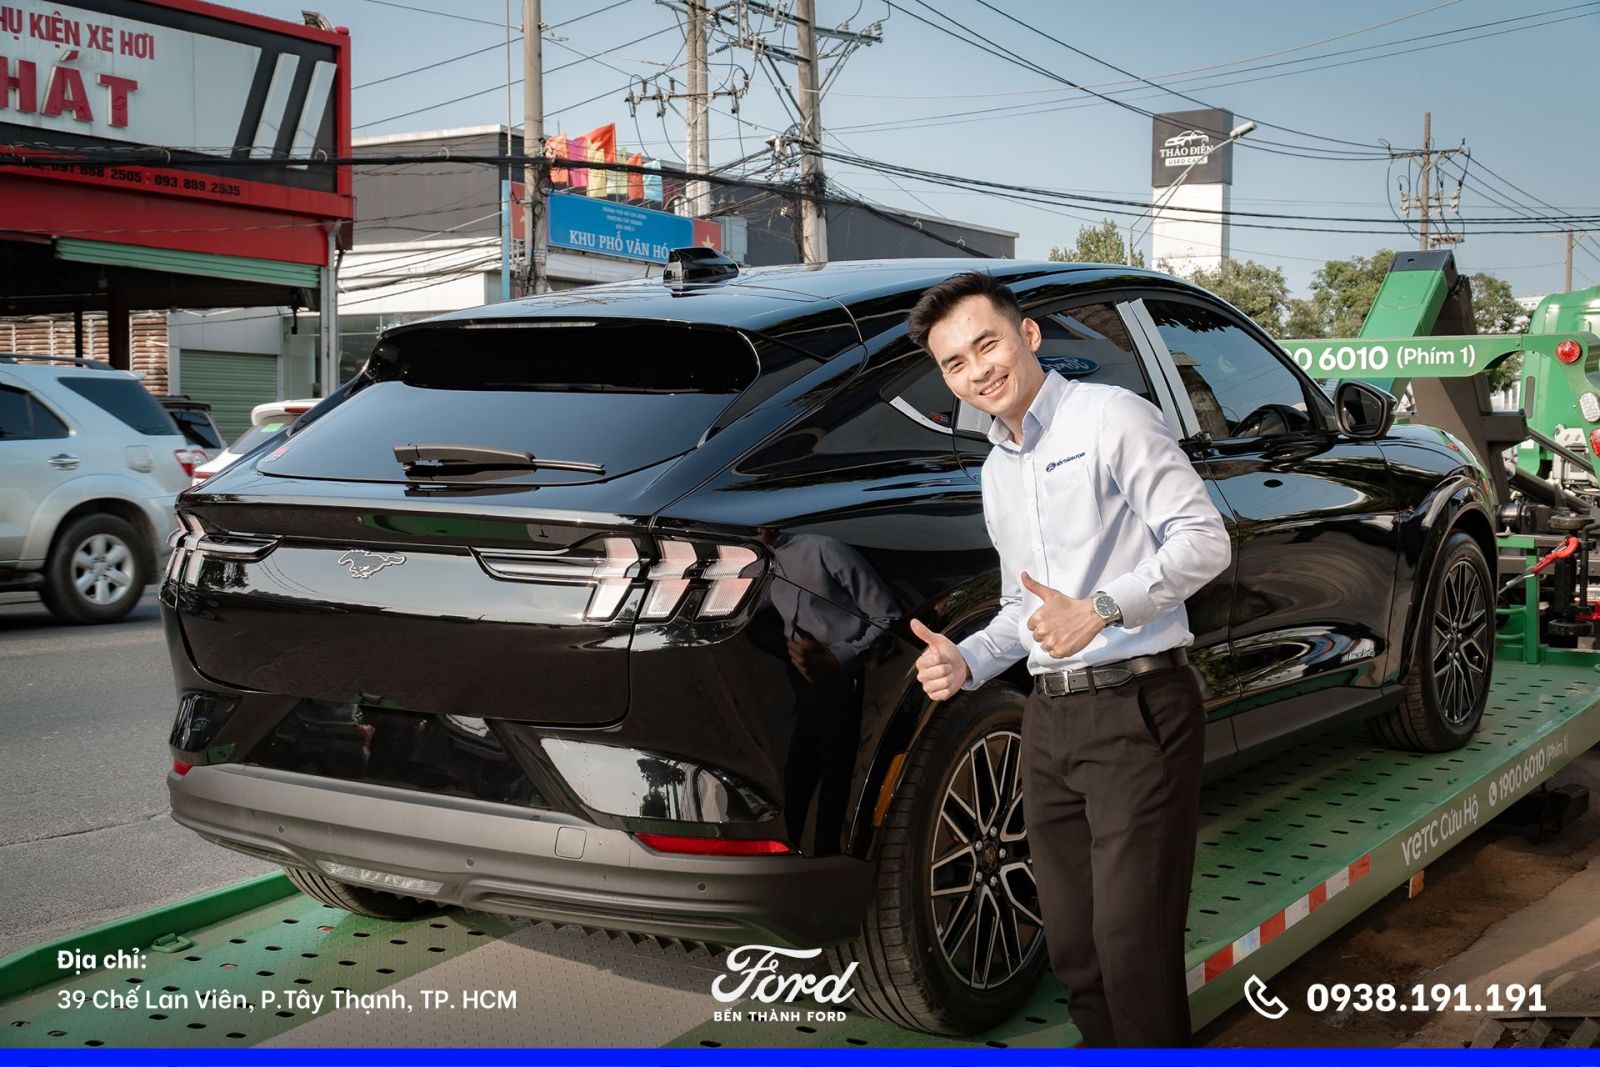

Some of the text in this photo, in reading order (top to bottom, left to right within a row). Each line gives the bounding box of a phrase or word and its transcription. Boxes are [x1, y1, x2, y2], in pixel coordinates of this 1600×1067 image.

[29, 11, 81, 48] KIỆN
[87, 23, 114, 53] XE
[120, 29, 155, 60] HƠI
[1160, 146, 1189, 158] THẢO
[569, 230, 670, 260] KHU PHỐ VĂN HÓ
[1318, 346, 1389, 371] 6010
[1396, 345, 1455, 369] (Phím
[1459, 344, 1476, 368] 1)
[1463, 793, 1479, 826] Hộ
[1499, 768, 1522, 802] 1900
[1523, 747, 1546, 783] 6010
